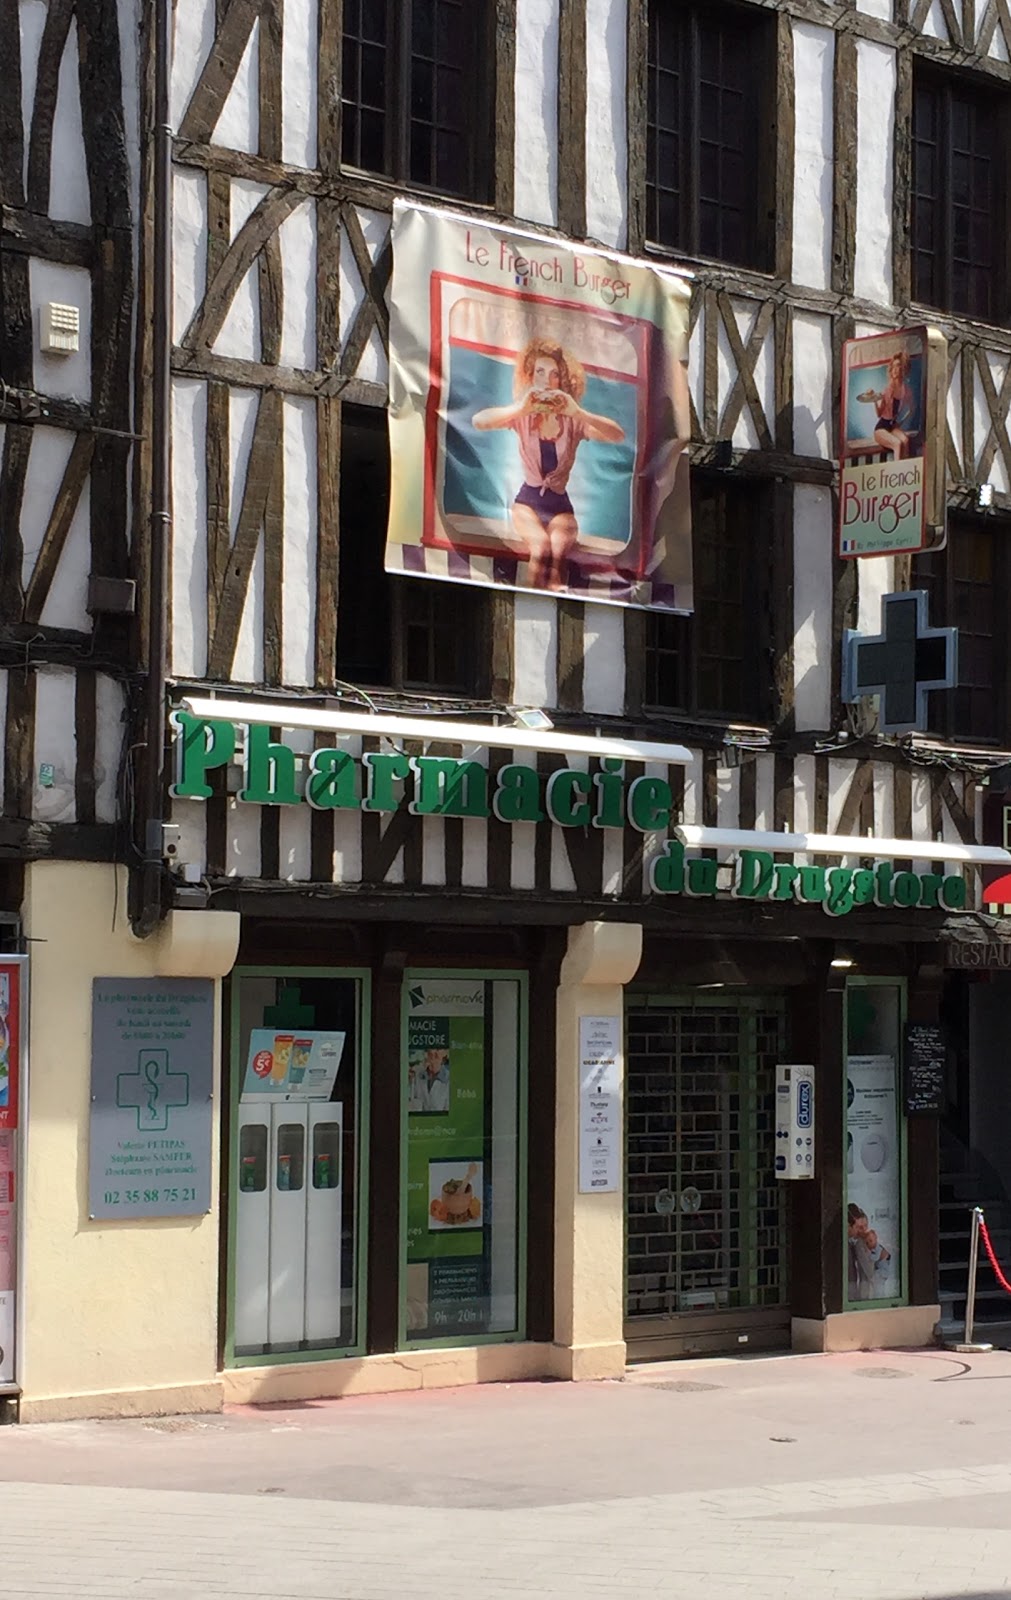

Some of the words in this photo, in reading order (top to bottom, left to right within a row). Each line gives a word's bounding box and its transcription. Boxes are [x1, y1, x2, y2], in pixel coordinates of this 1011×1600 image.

[466, 231, 489, 267] Le
[500, 240, 563, 284] French
[573, 256, 631, 305] Burger
[843, 481, 919, 534] Burger
[168, 710, 673, 832] Pharmacie
[650, 840, 718, 896] du
[731, 850, 967, 917] Drugstore
[798, 1083, 811, 1124] durex
[104, 1190, 120, 1204] 02
[125, 1190, 140, 1203] 35
[143, 1189, 159, 1202] 88
[163, 1188, 178, 1201] 75
[182, 1188, 196, 1201] 21
